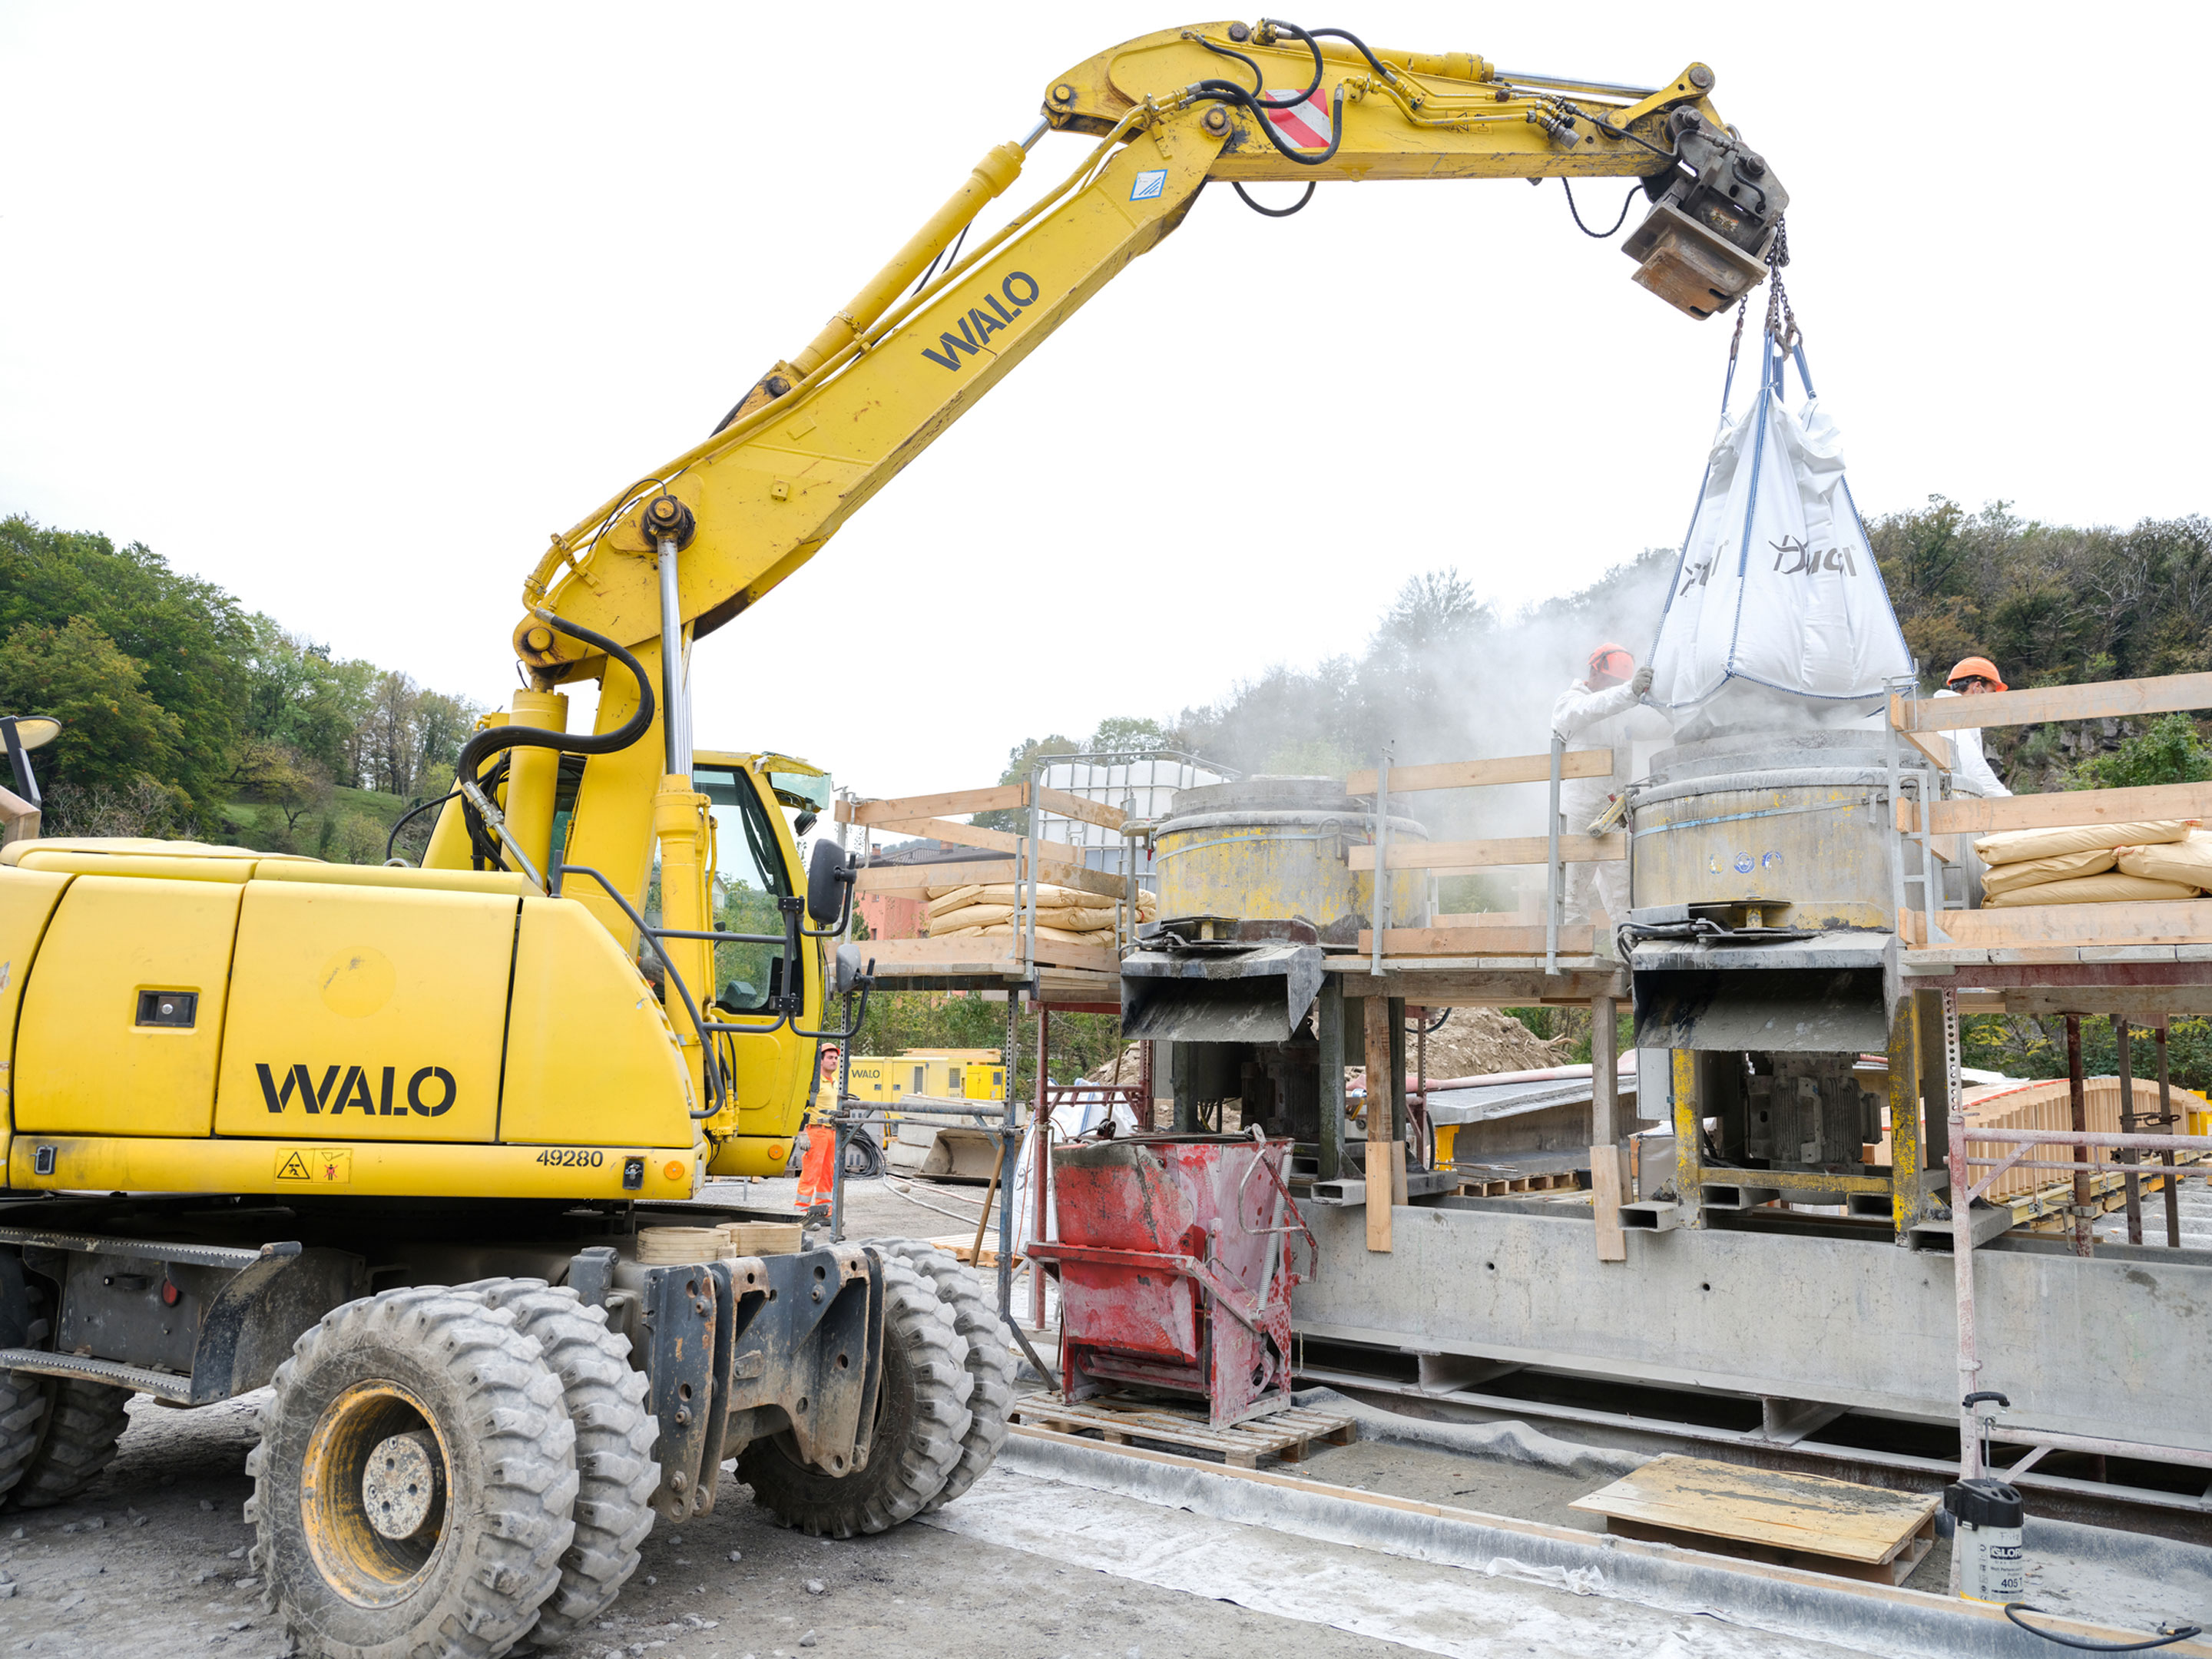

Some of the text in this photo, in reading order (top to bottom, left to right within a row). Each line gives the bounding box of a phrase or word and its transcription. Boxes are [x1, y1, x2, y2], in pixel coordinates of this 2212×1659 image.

[921, 271, 1039, 372] WALO
[851, 1069, 880, 1078] WALO
[255, 1063, 456, 1117] WALO
[536, 1149, 604, 1168] 49280
[2001, 1578, 2018, 1588] 405
